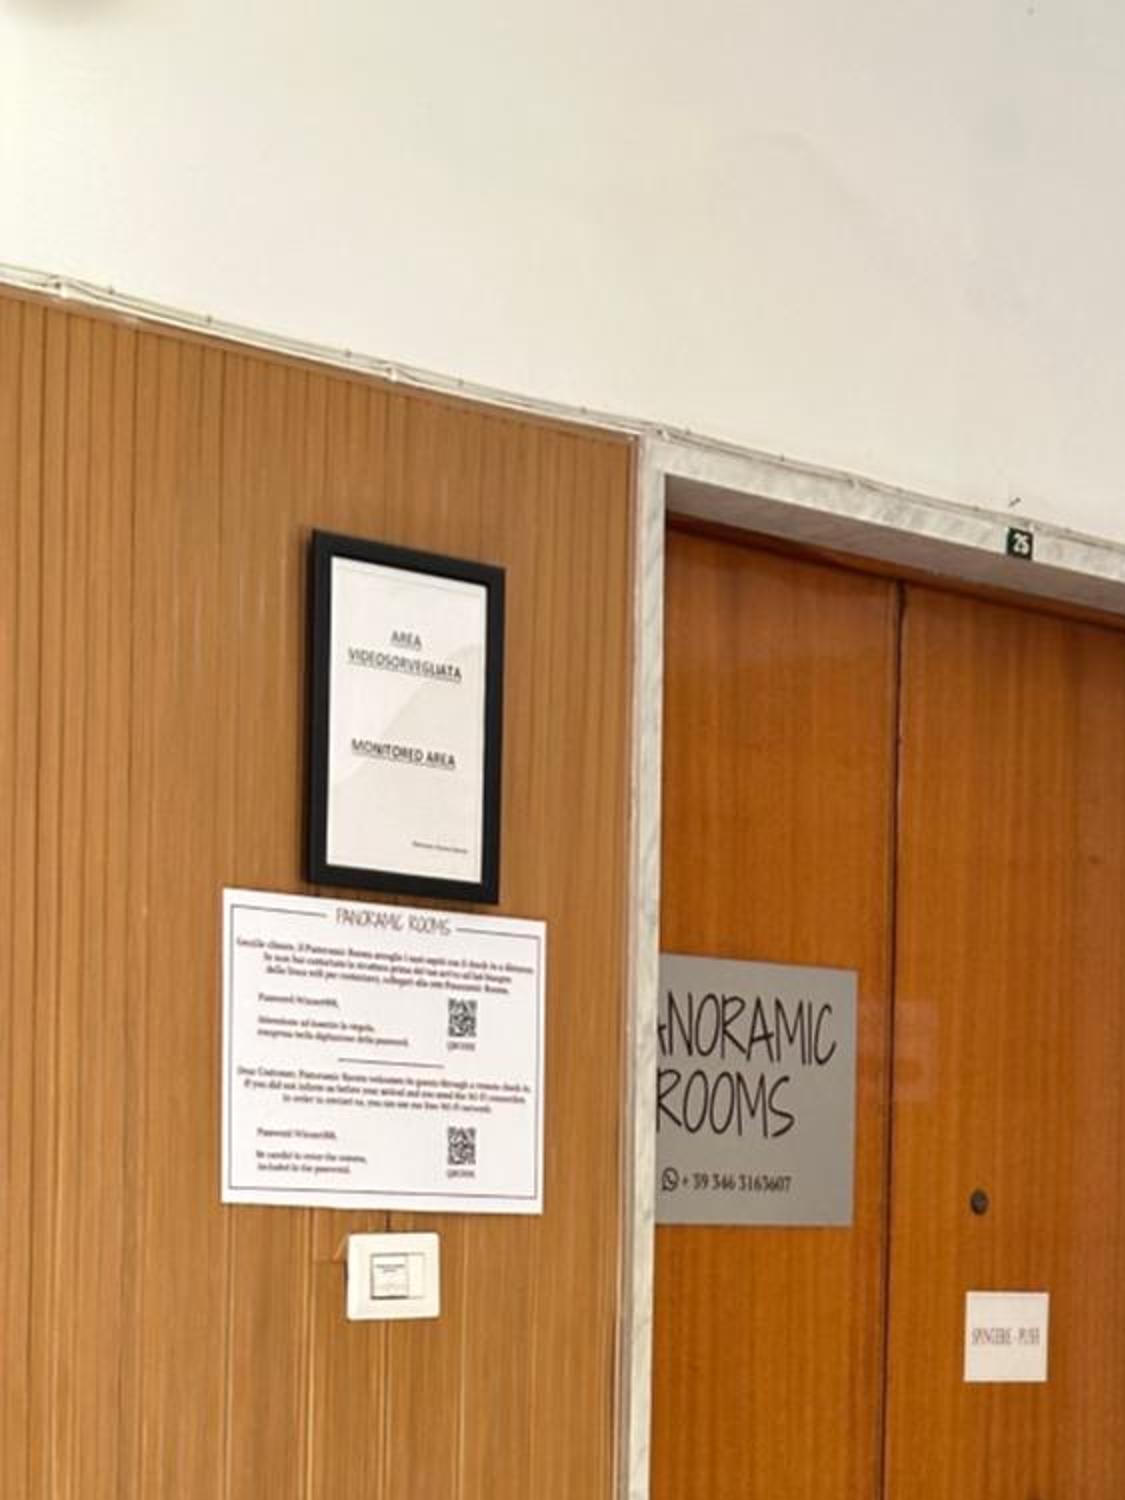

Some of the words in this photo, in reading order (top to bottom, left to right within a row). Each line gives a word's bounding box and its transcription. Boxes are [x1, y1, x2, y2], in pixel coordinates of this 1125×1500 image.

[390, 630, 423, 648] AREA
[348, 647, 463, 679] VIDEOSORVEGLIATA
[351, 738, 424, 763] MONITORED
[426, 751, 456, 768] AREA
[656, 1067, 796, 1139] ROOMS
